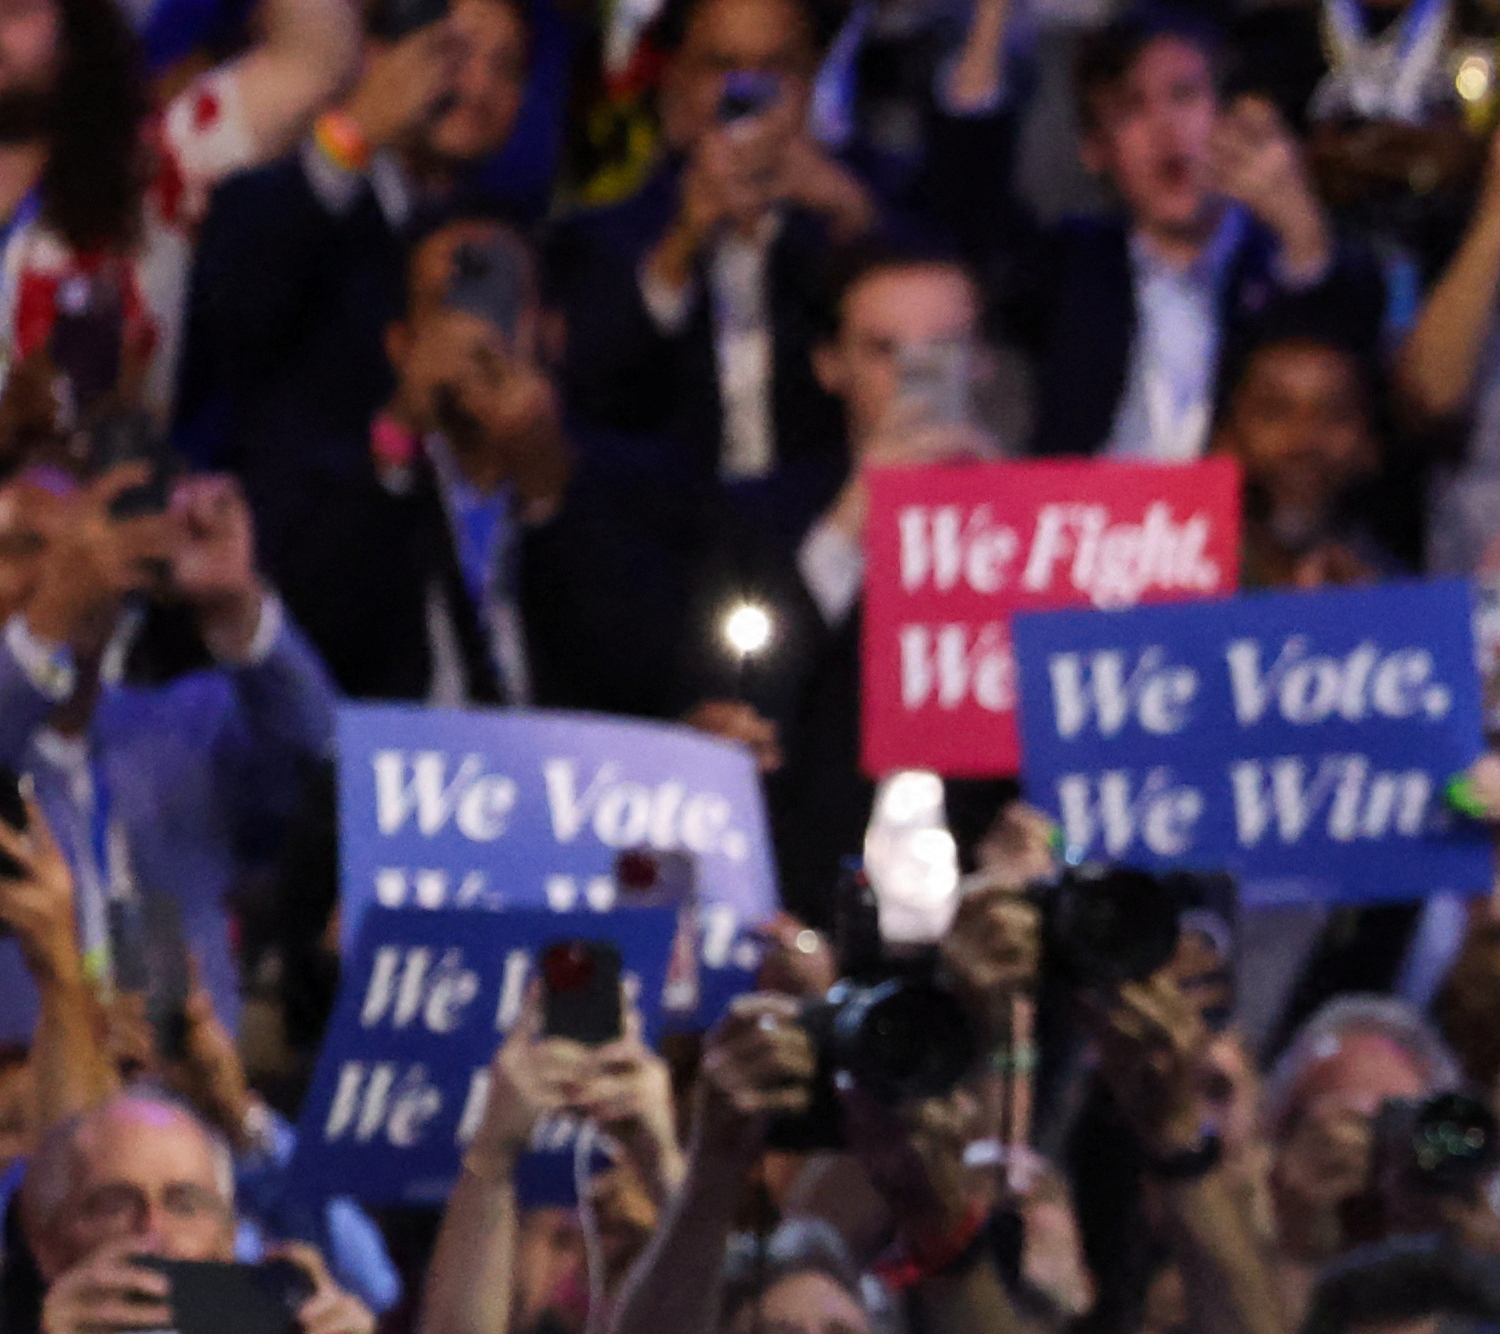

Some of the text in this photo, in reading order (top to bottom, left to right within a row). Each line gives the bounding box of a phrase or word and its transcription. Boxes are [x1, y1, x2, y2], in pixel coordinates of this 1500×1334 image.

[897, 499, 1222, 610] We Fight.
[1050, 633, 1452, 741] We Vote.
[373, 750, 750, 861] We Vote.
[1058, 765, 1204, 859] We
[360, 945, 480, 1033] We
[324, 1060, 442, 1149] We
